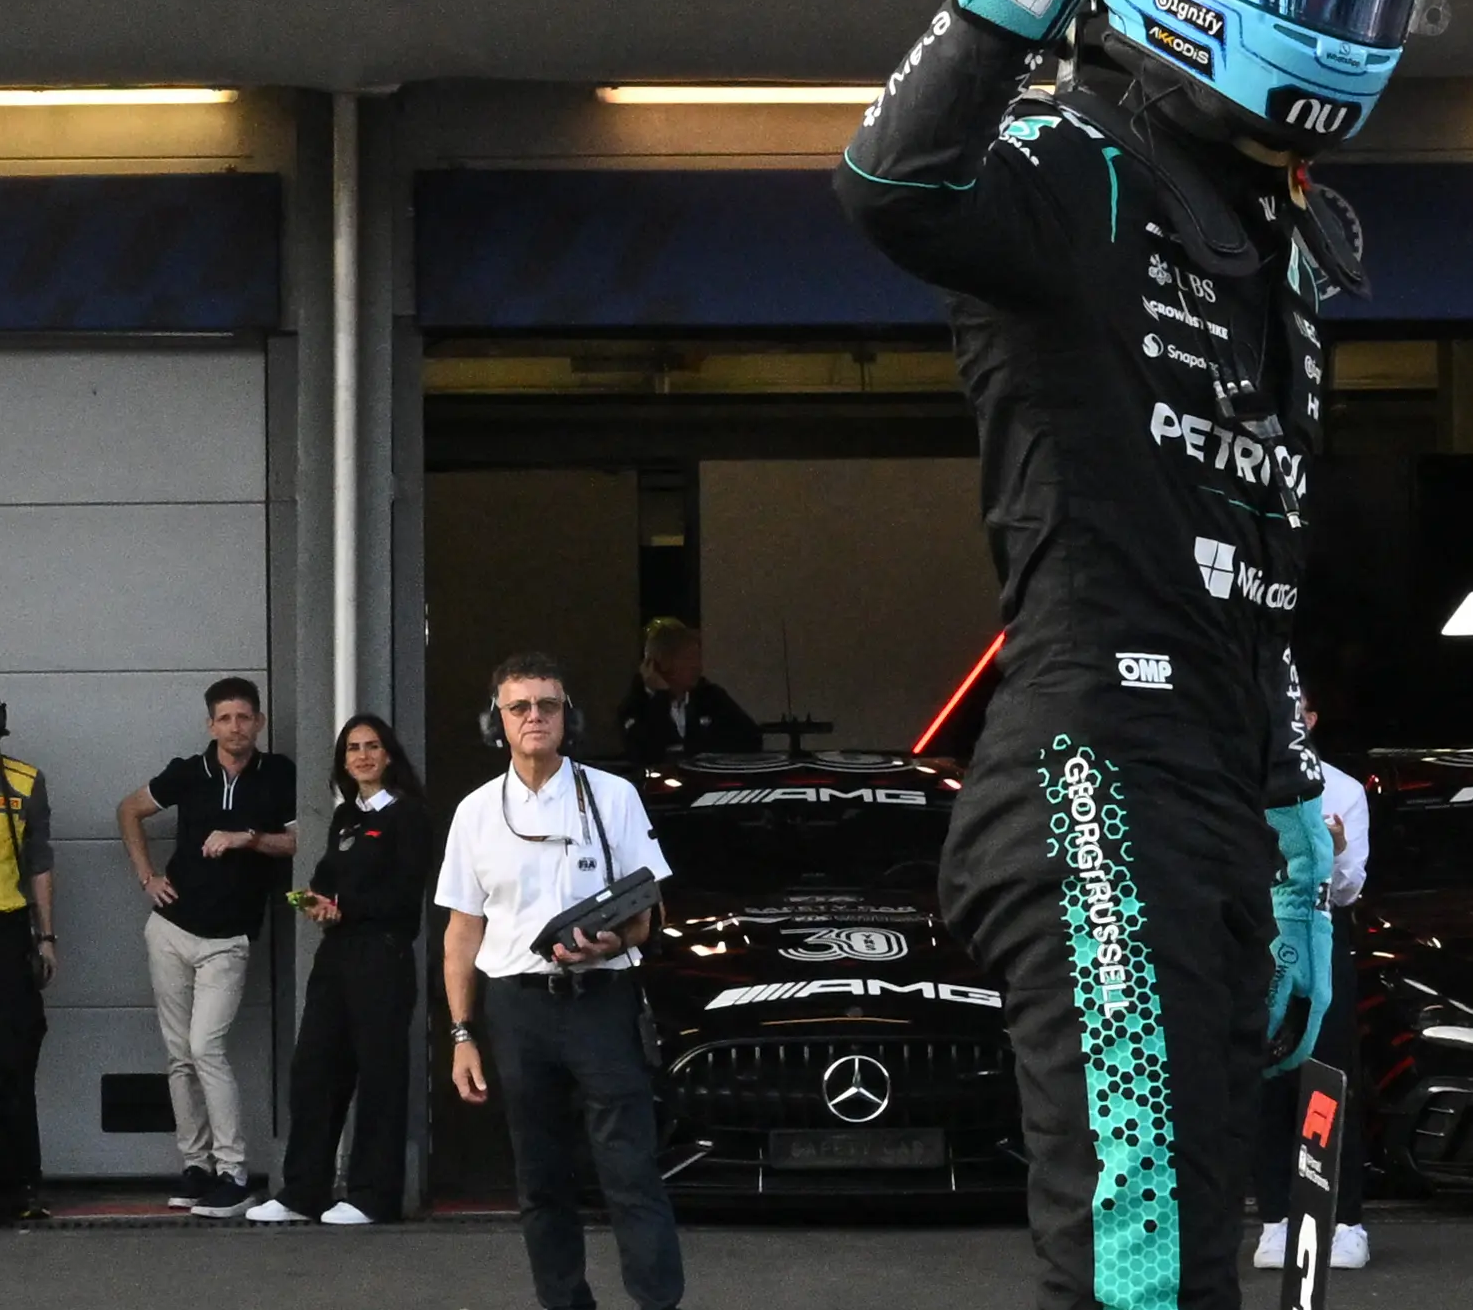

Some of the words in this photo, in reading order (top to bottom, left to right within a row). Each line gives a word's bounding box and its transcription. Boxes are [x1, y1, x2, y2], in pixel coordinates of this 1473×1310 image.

[1118, 658, 1172, 683] OMP
[1085, 879, 1129, 1019] RUSSELL
[797, 979, 1002, 1008] AMG
